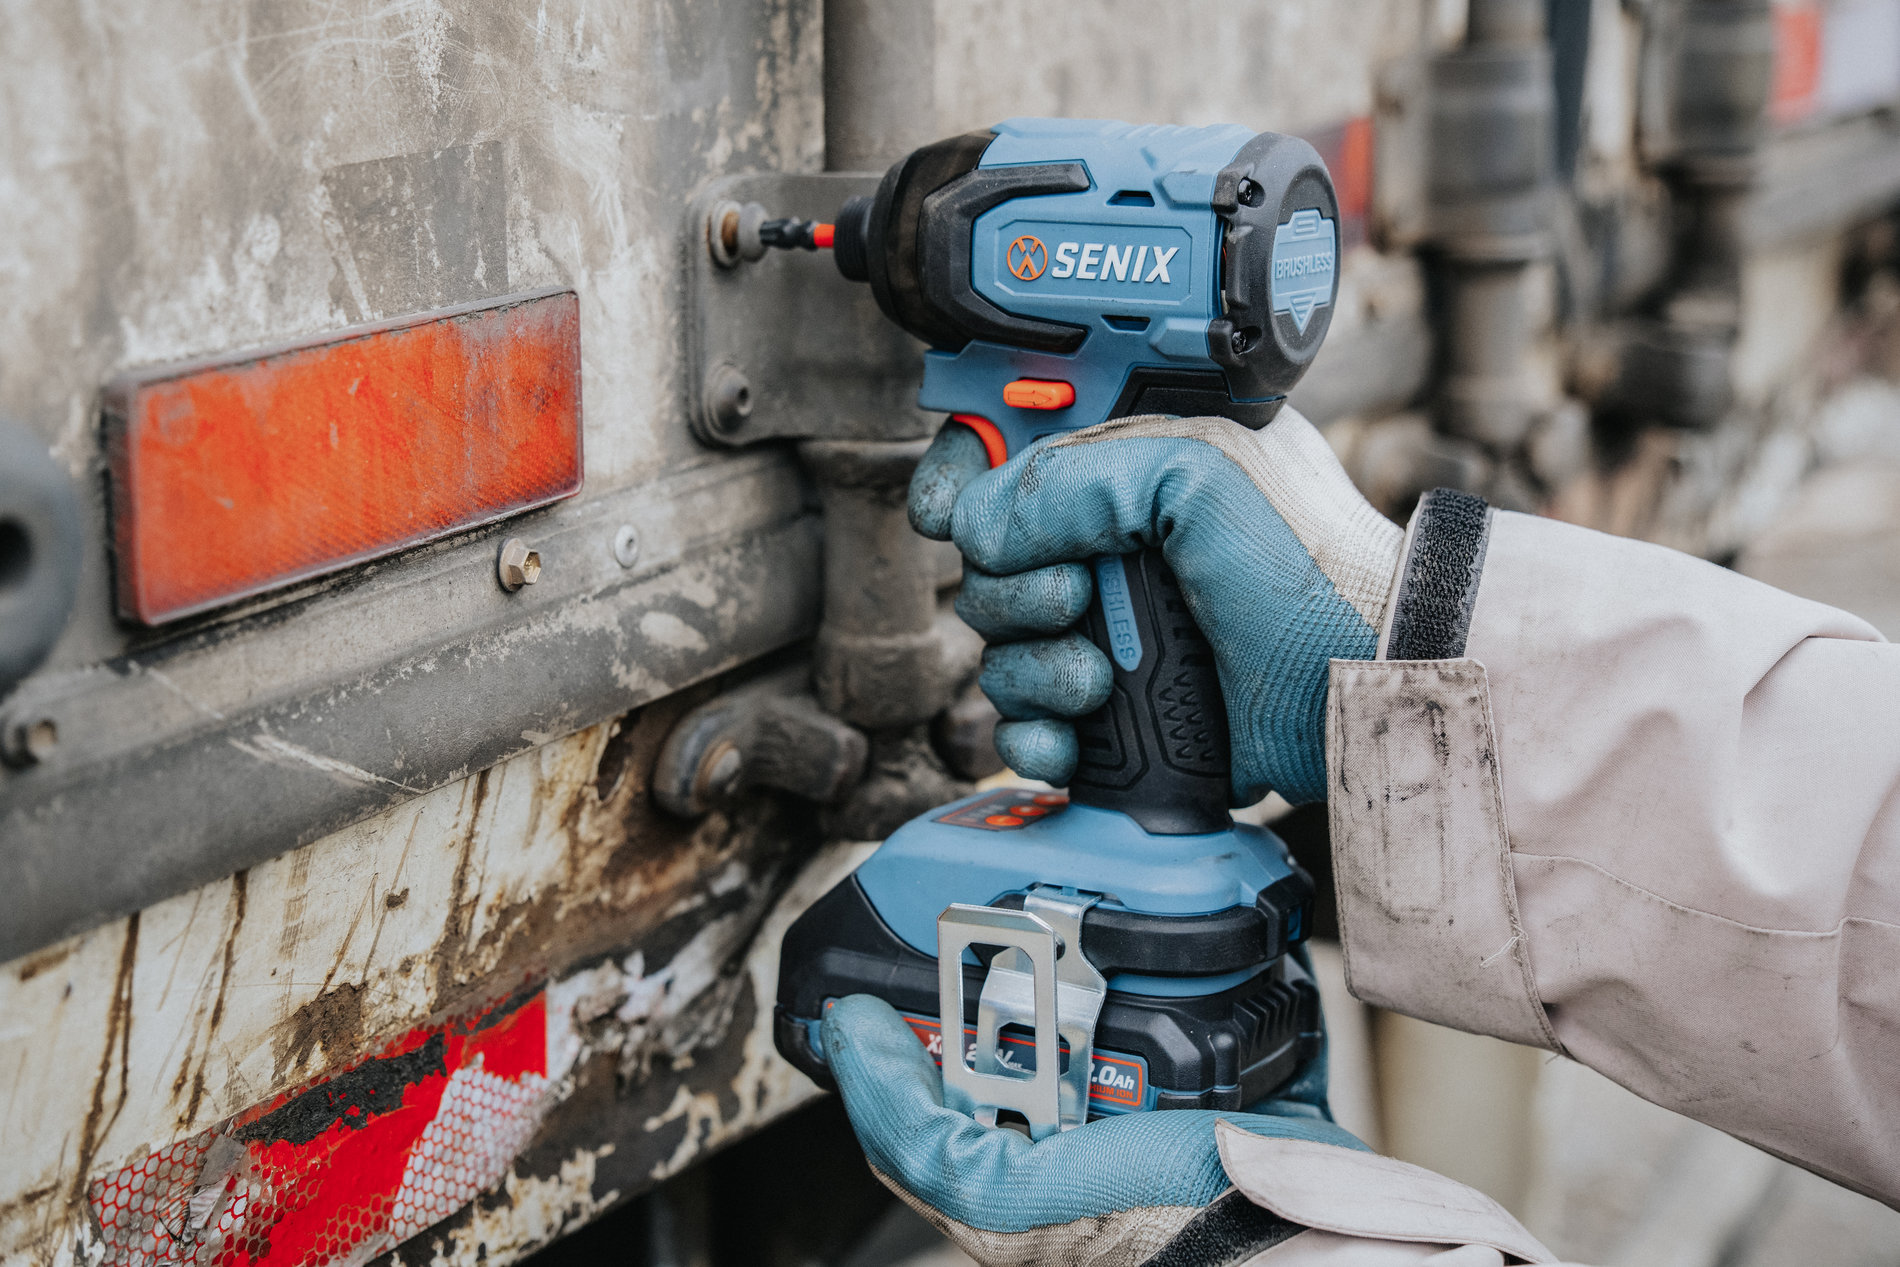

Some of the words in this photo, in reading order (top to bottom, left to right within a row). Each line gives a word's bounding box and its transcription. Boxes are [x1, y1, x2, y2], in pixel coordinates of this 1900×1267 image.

[1051, 241, 1181, 284] SENIX
[1274, 252, 1334, 280] BRUSHLESS
[1098, 556, 1136, 661] USHLESS
[1090, 1062, 1135, 1090] .0Ah
[1116, 1088, 1134, 1099] ION
